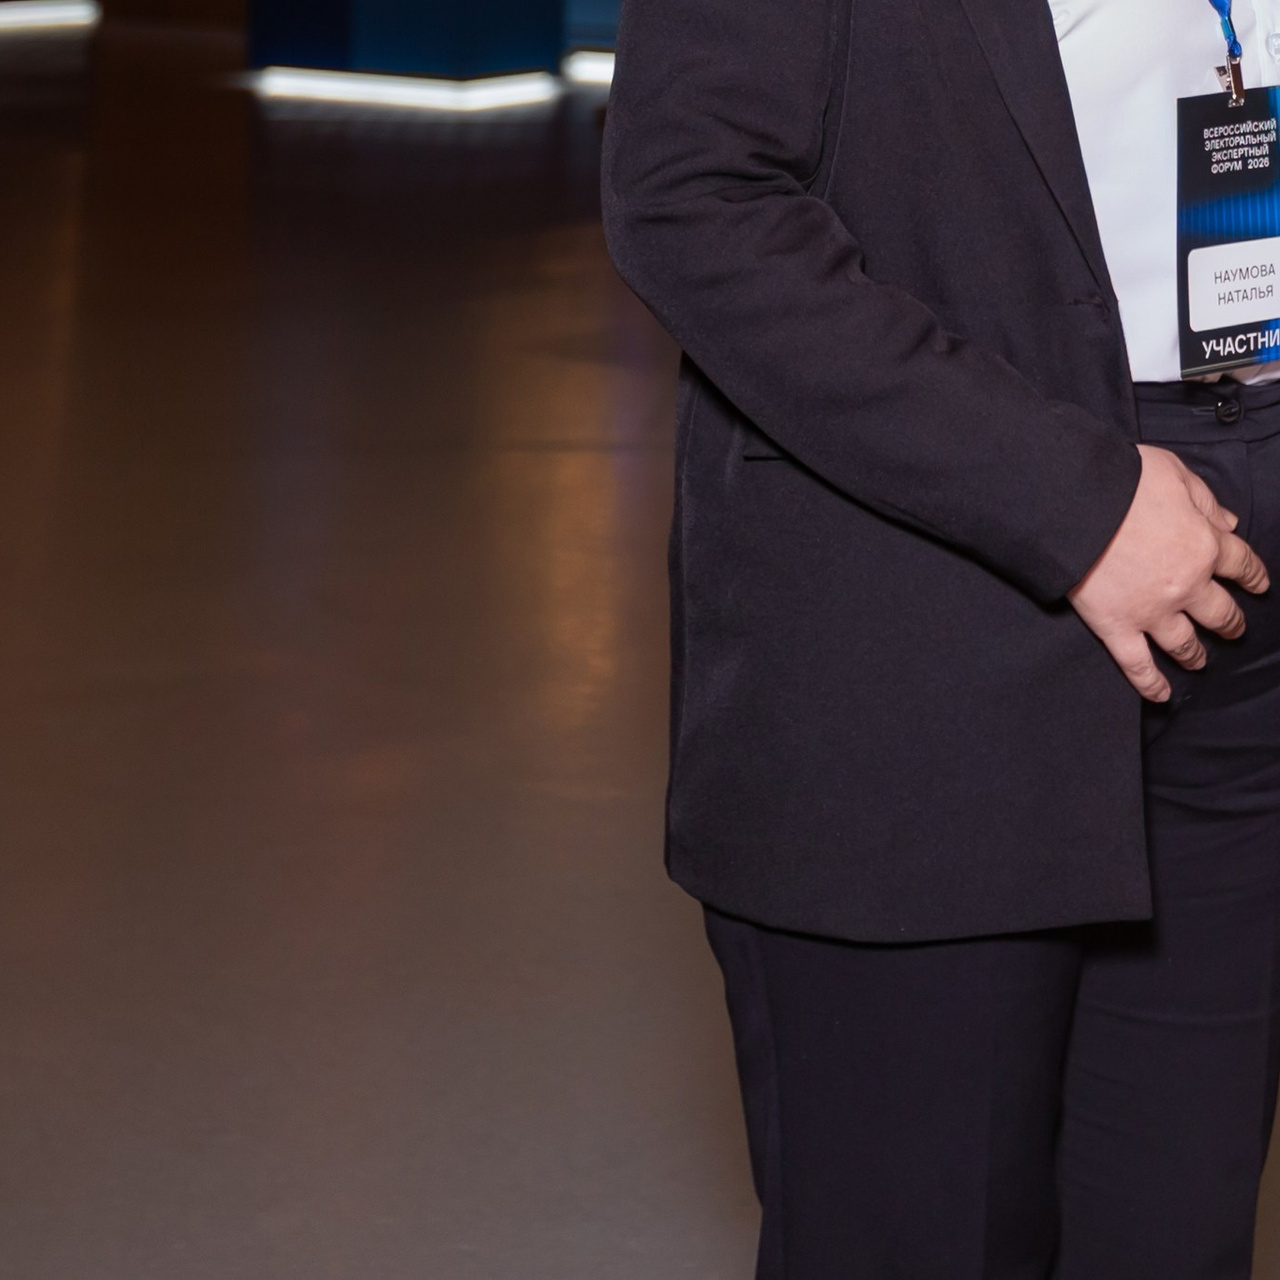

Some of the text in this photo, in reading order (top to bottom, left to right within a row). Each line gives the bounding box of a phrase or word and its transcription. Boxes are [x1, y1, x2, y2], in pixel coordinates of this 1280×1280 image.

[1203, 117, 1277, 139] ВСЕРОССИЙСКИЙ
[1204, 130, 1277, 151] ЭЛЕКТОРАЛЬНЫЙ
[1211, 143, 1270, 162] ЭКСПЕРТНЫЙ
[1211, 157, 1270, 174] ФОРУМ 2026
[1214, 263, 1276, 285] НАУМОВА
[1218, 284, 1274, 306] НАТАЛЬЯ
